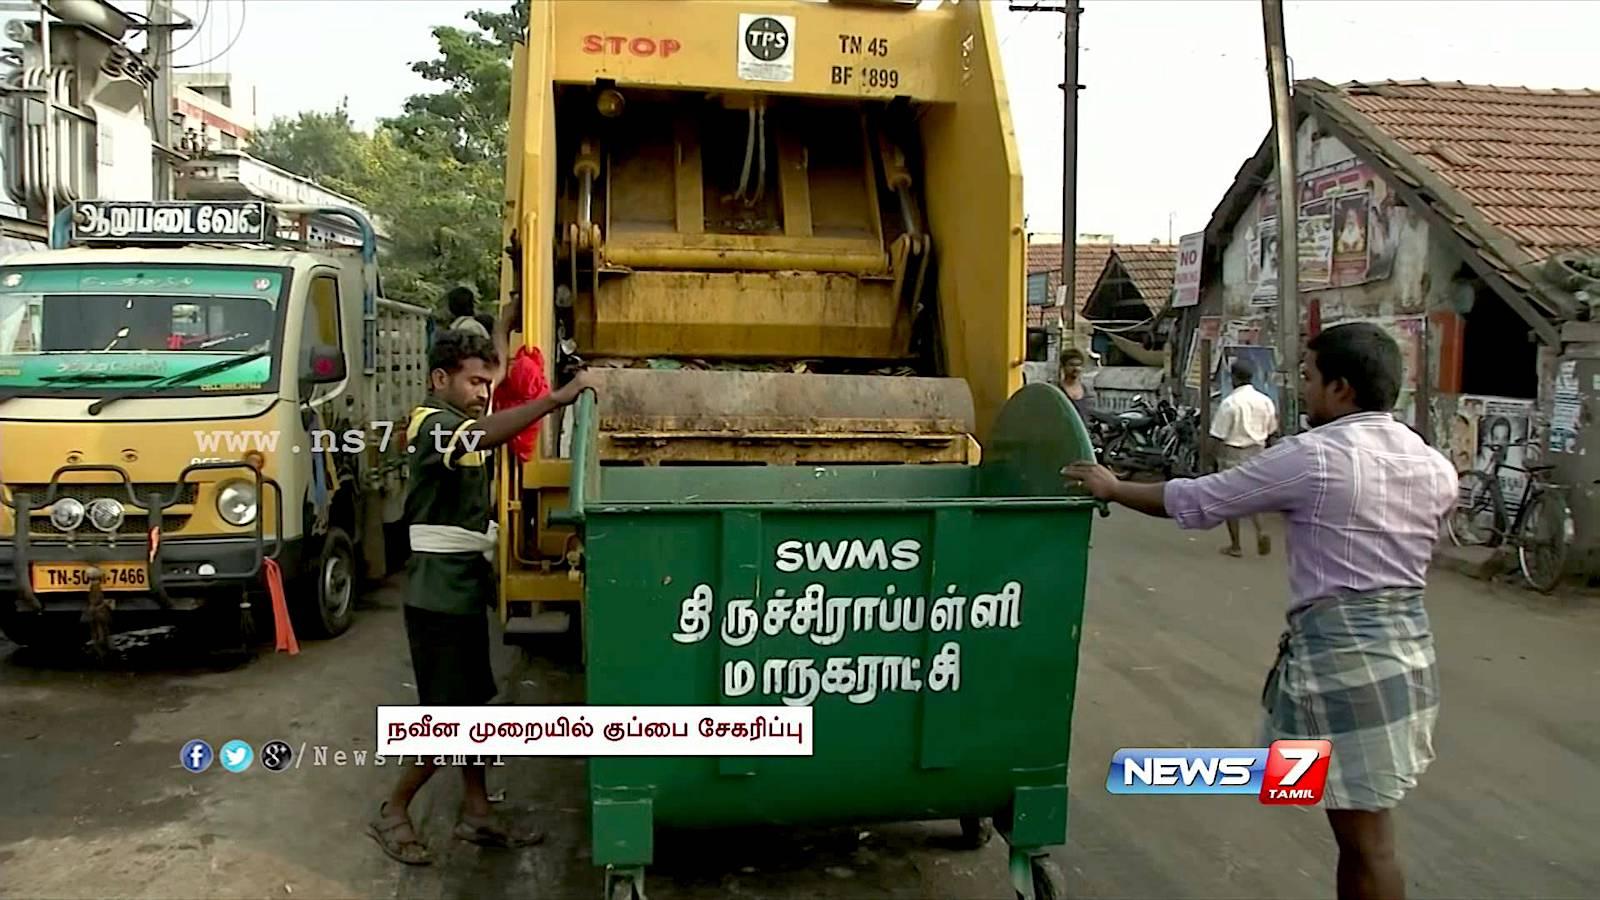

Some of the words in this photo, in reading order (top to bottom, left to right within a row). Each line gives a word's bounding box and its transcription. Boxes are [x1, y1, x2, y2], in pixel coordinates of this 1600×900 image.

[582, 34, 681, 58] STOP
[749, 30, 787, 49] TPS
[839, 34, 863, 54] TN
[868, 37, 888, 57] 45
[832, 66, 854, 85] BF
[1180, 249, 1198, 267] NO
[775, 539, 922, 572] SWMS
